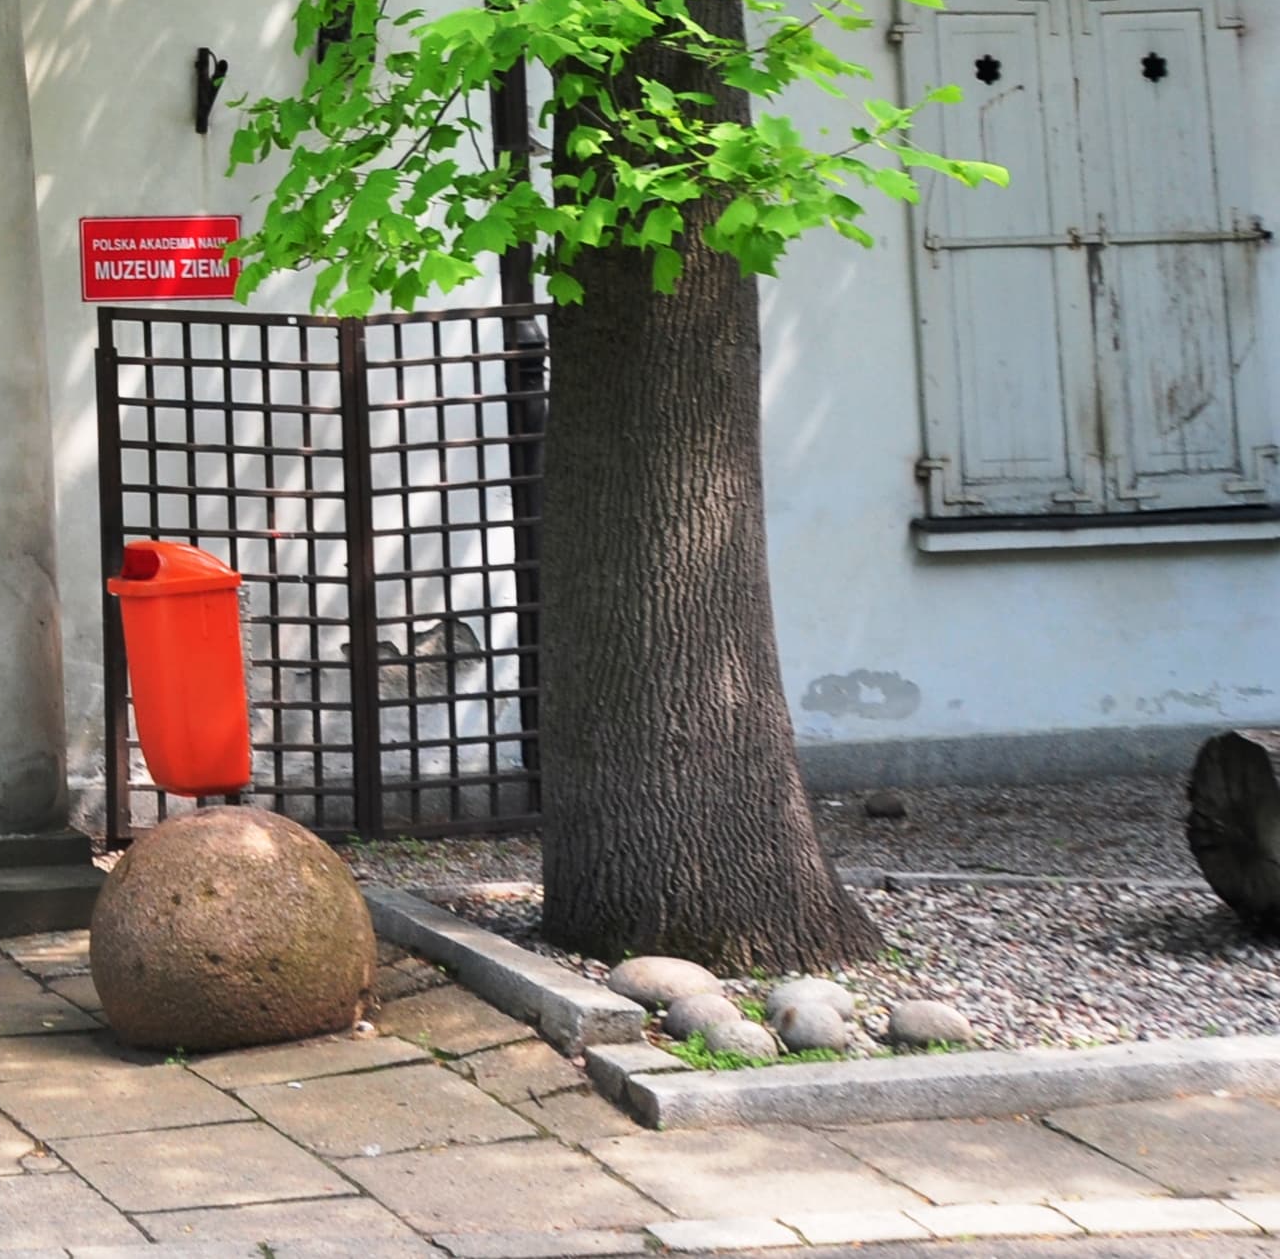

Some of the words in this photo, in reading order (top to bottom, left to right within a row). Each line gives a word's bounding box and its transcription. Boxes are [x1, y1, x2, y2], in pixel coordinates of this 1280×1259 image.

[93, 238, 137, 251] POLSKA
[140, 237, 196, 250] AKADEMIA
[95, 260, 175, 280] MUZEUM
[180, 258, 230, 278] ZIEMI
